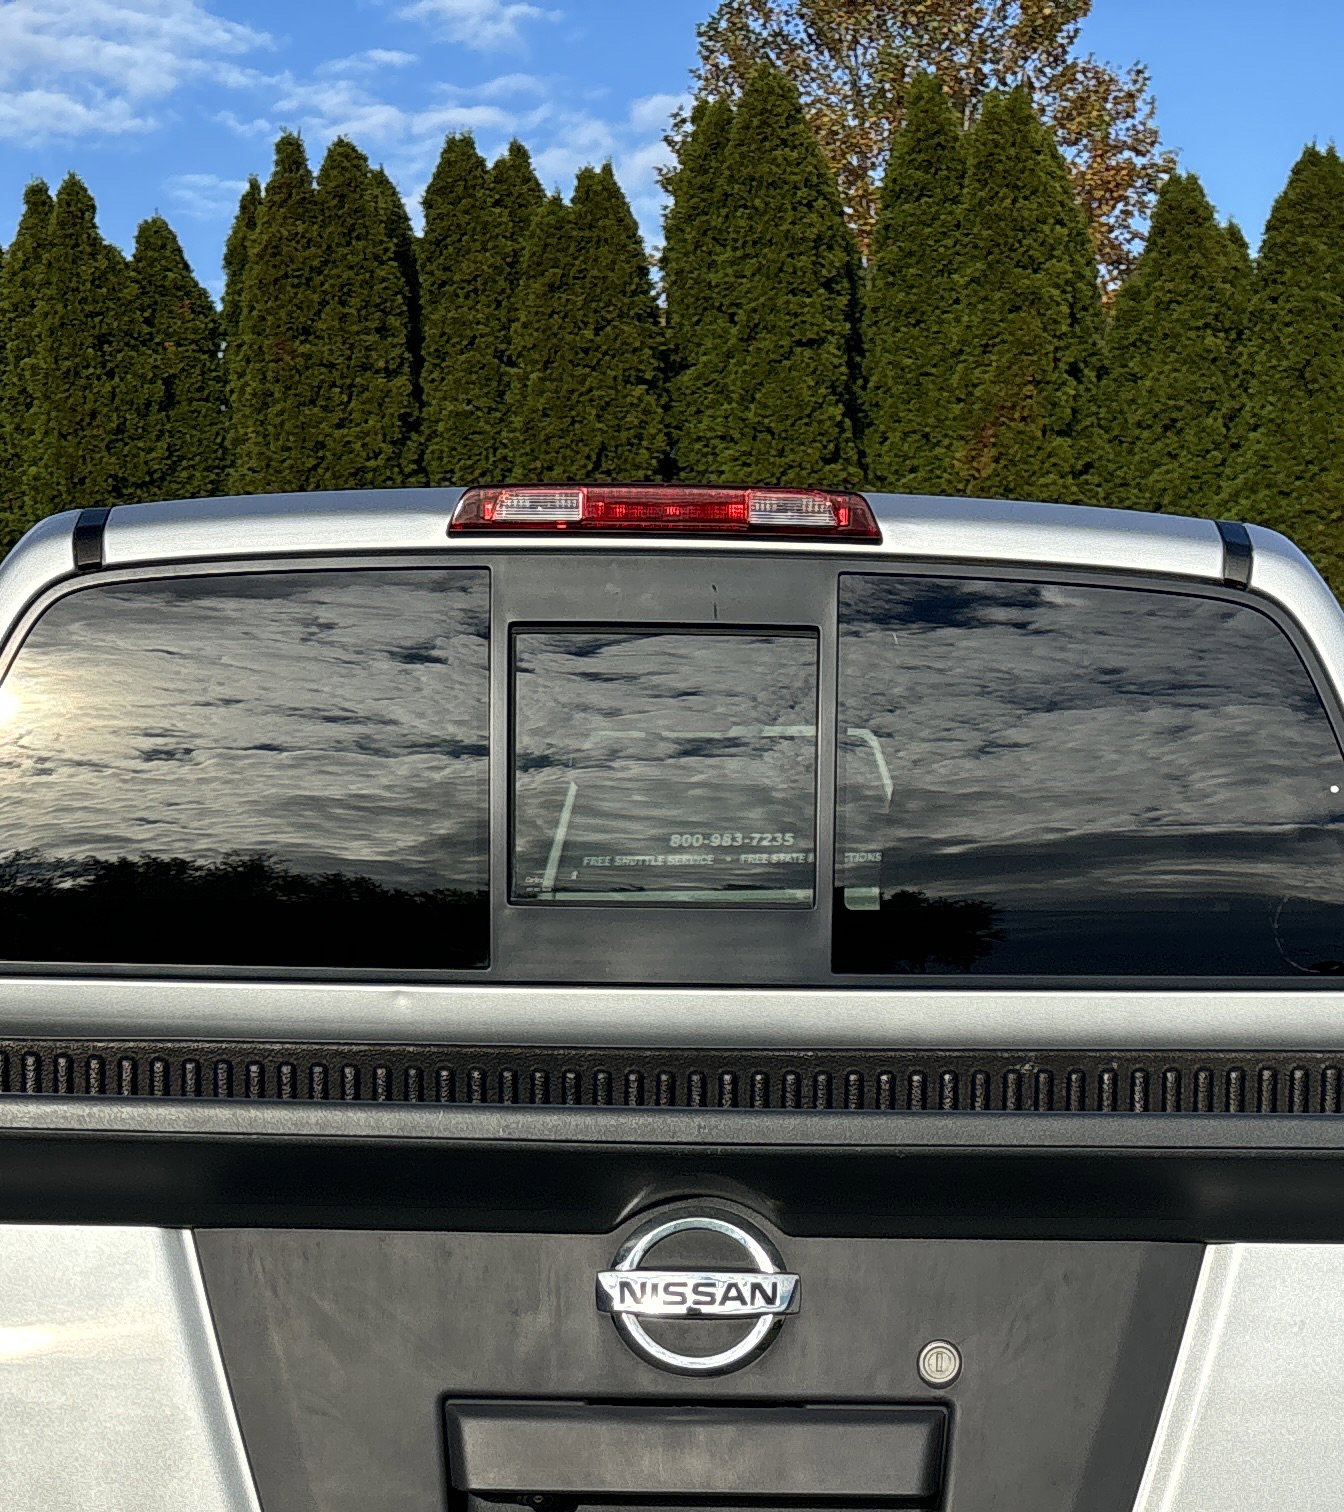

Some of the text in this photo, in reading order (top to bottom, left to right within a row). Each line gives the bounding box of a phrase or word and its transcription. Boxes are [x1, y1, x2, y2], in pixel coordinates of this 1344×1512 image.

[669, 833, 795, 848] 800-983-7235
[582, 856, 613, 867] FREE
[613, 855, 665, 866] SHUTTLE
[666, 854, 715, 865] SERVICE
[739, 854, 769, 864] FREE
[769, 853, 806, 864] STATE
[619, 1280, 778, 1306] NISSAN
